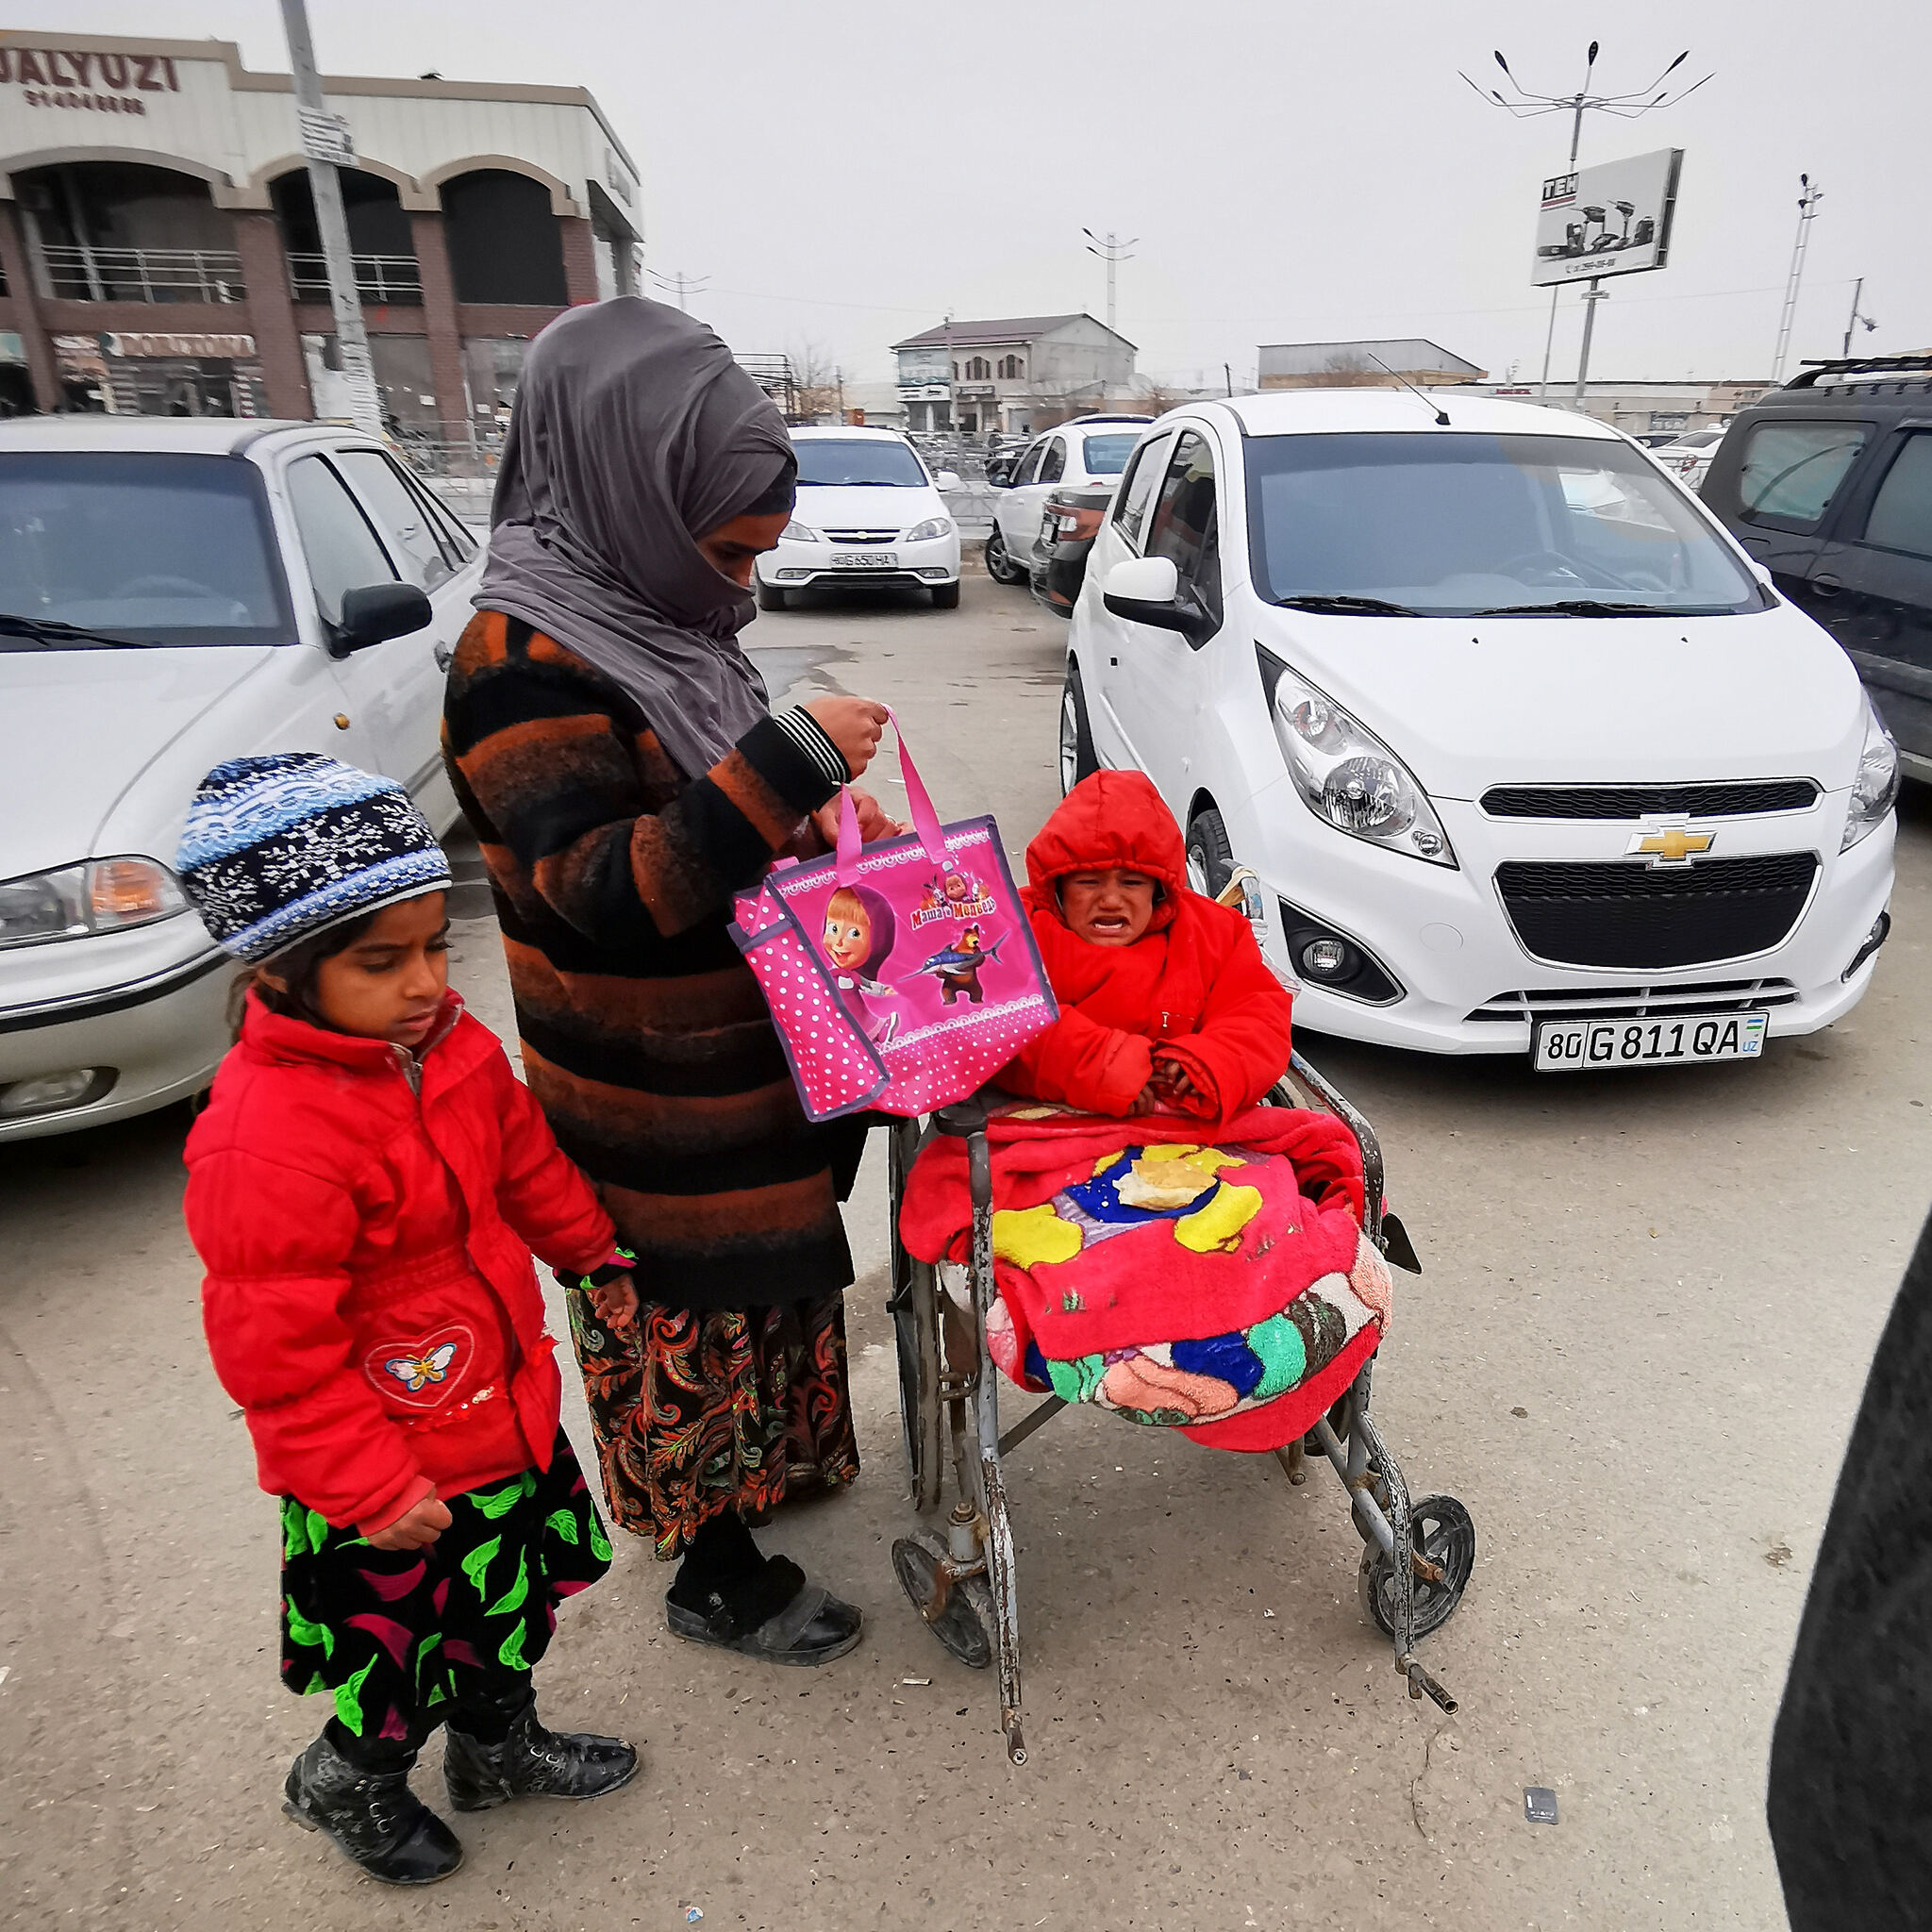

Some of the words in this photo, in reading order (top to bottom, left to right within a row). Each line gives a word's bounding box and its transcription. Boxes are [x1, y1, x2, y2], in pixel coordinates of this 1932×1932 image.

[910, 908, 944, 930] Маша
[1547, 1033, 1582, 1059] 80
[1742, 1041, 1758, 1053] UZ
